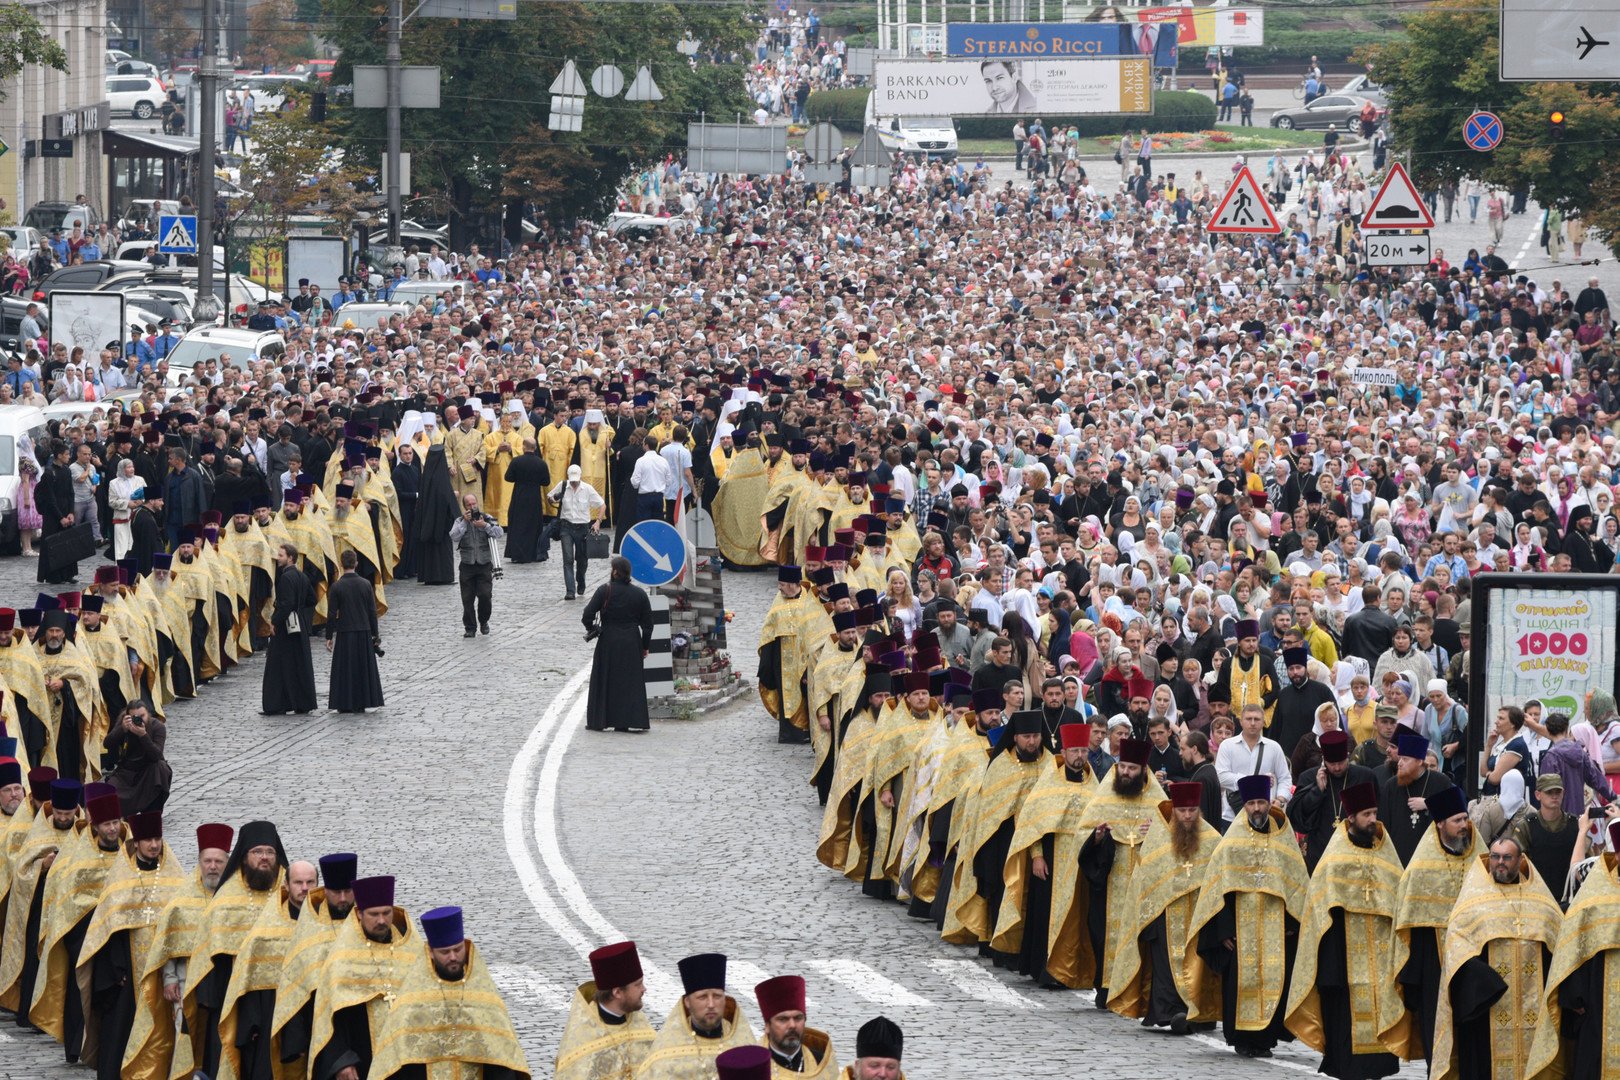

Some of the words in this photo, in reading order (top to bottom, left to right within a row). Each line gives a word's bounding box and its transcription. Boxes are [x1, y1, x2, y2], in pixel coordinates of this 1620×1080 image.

[964, 37, 1047, 54] STEFANO
[1052, 37, 1103, 54] RICCI
[887, 75, 969, 87] BARKANOV
[1124, 61, 1134, 94] ЗВУК
[1134, 61, 1145, 111] ЖИВИЙ
[887, 89, 929, 100] BAND
[1353, 369, 1396, 385] Никополь
[1516, 599, 1588, 616] ОТРИМУЙ
[1526, 619, 1579, 631] ЩОДНЯ
[1515, 631, 1588, 656] 1000
